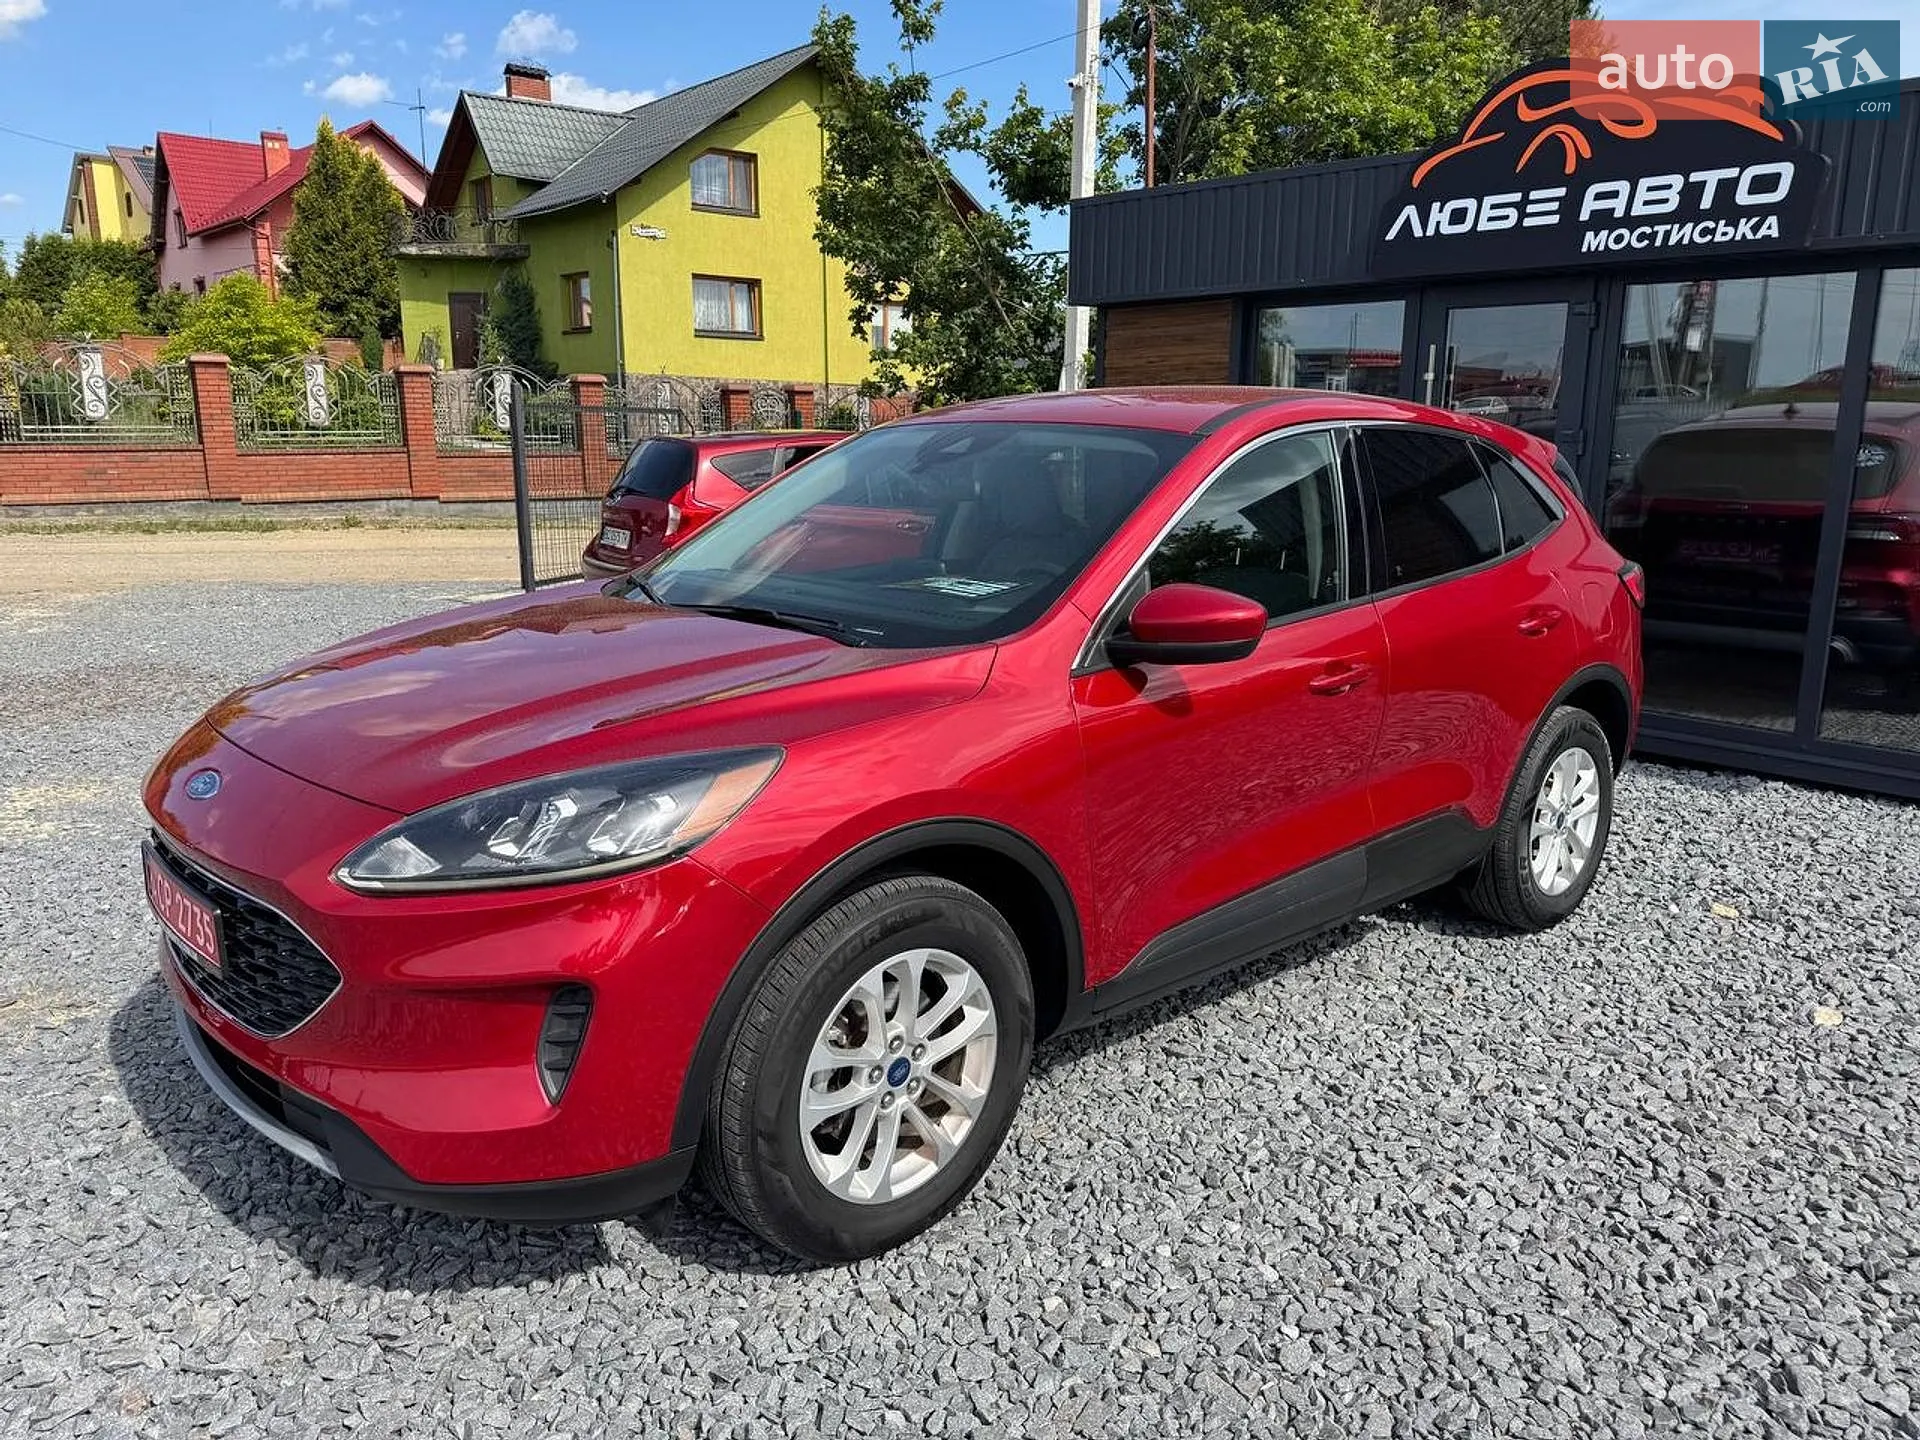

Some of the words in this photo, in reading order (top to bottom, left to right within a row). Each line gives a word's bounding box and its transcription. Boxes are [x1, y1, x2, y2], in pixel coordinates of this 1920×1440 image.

[1385, 187, 1567, 241] ЛЮБЕ
[1579, 161, 1795, 221] АВТО
[1580, 215, 1780, 253] МОСТИСЬКА
[175, 892, 214, 955] 2735
